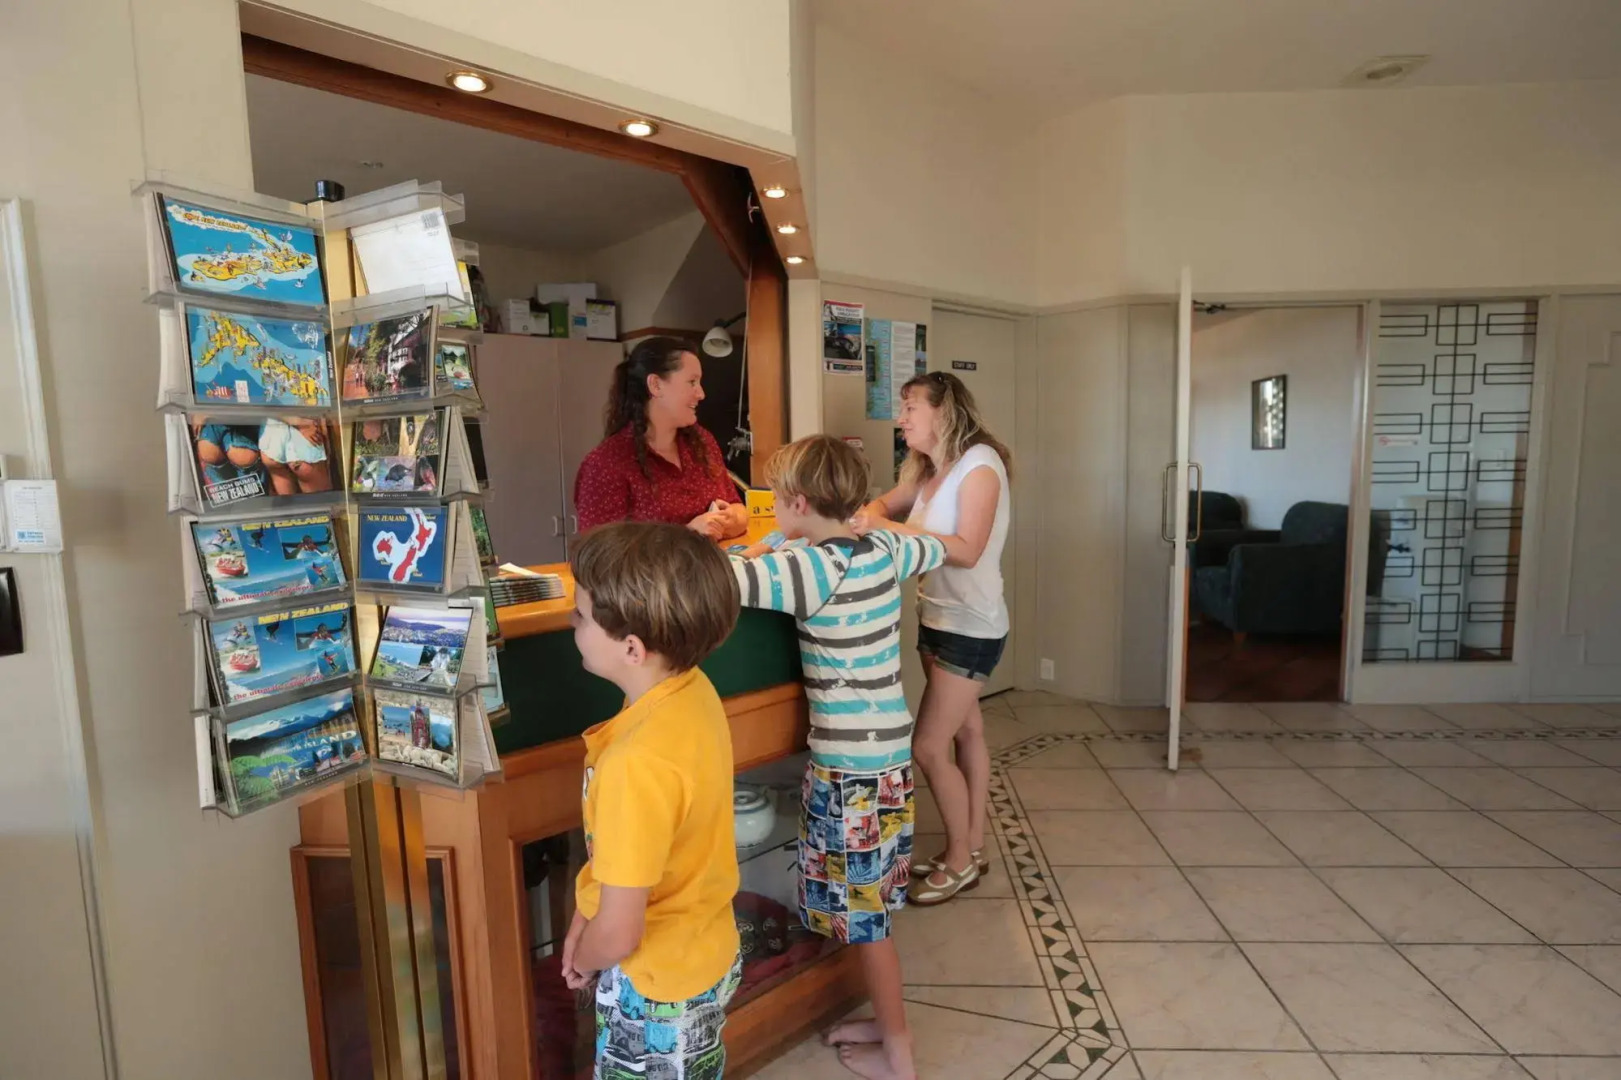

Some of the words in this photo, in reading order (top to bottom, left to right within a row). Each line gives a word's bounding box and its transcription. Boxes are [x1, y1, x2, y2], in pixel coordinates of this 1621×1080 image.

[209, 483, 234, 493] BEACH
[234, 477, 256, 487] BUMS
[211, 490, 230, 504] NEW
[228, 482, 260, 500] ZEALAND
[274, 515, 330, 528] ZEALAND
[258, 612, 290, 625] NEW
[292, 602, 349, 619] ZEALAND
[233, 691, 247, 700] the
[305, 730, 357, 747] ISLAND
